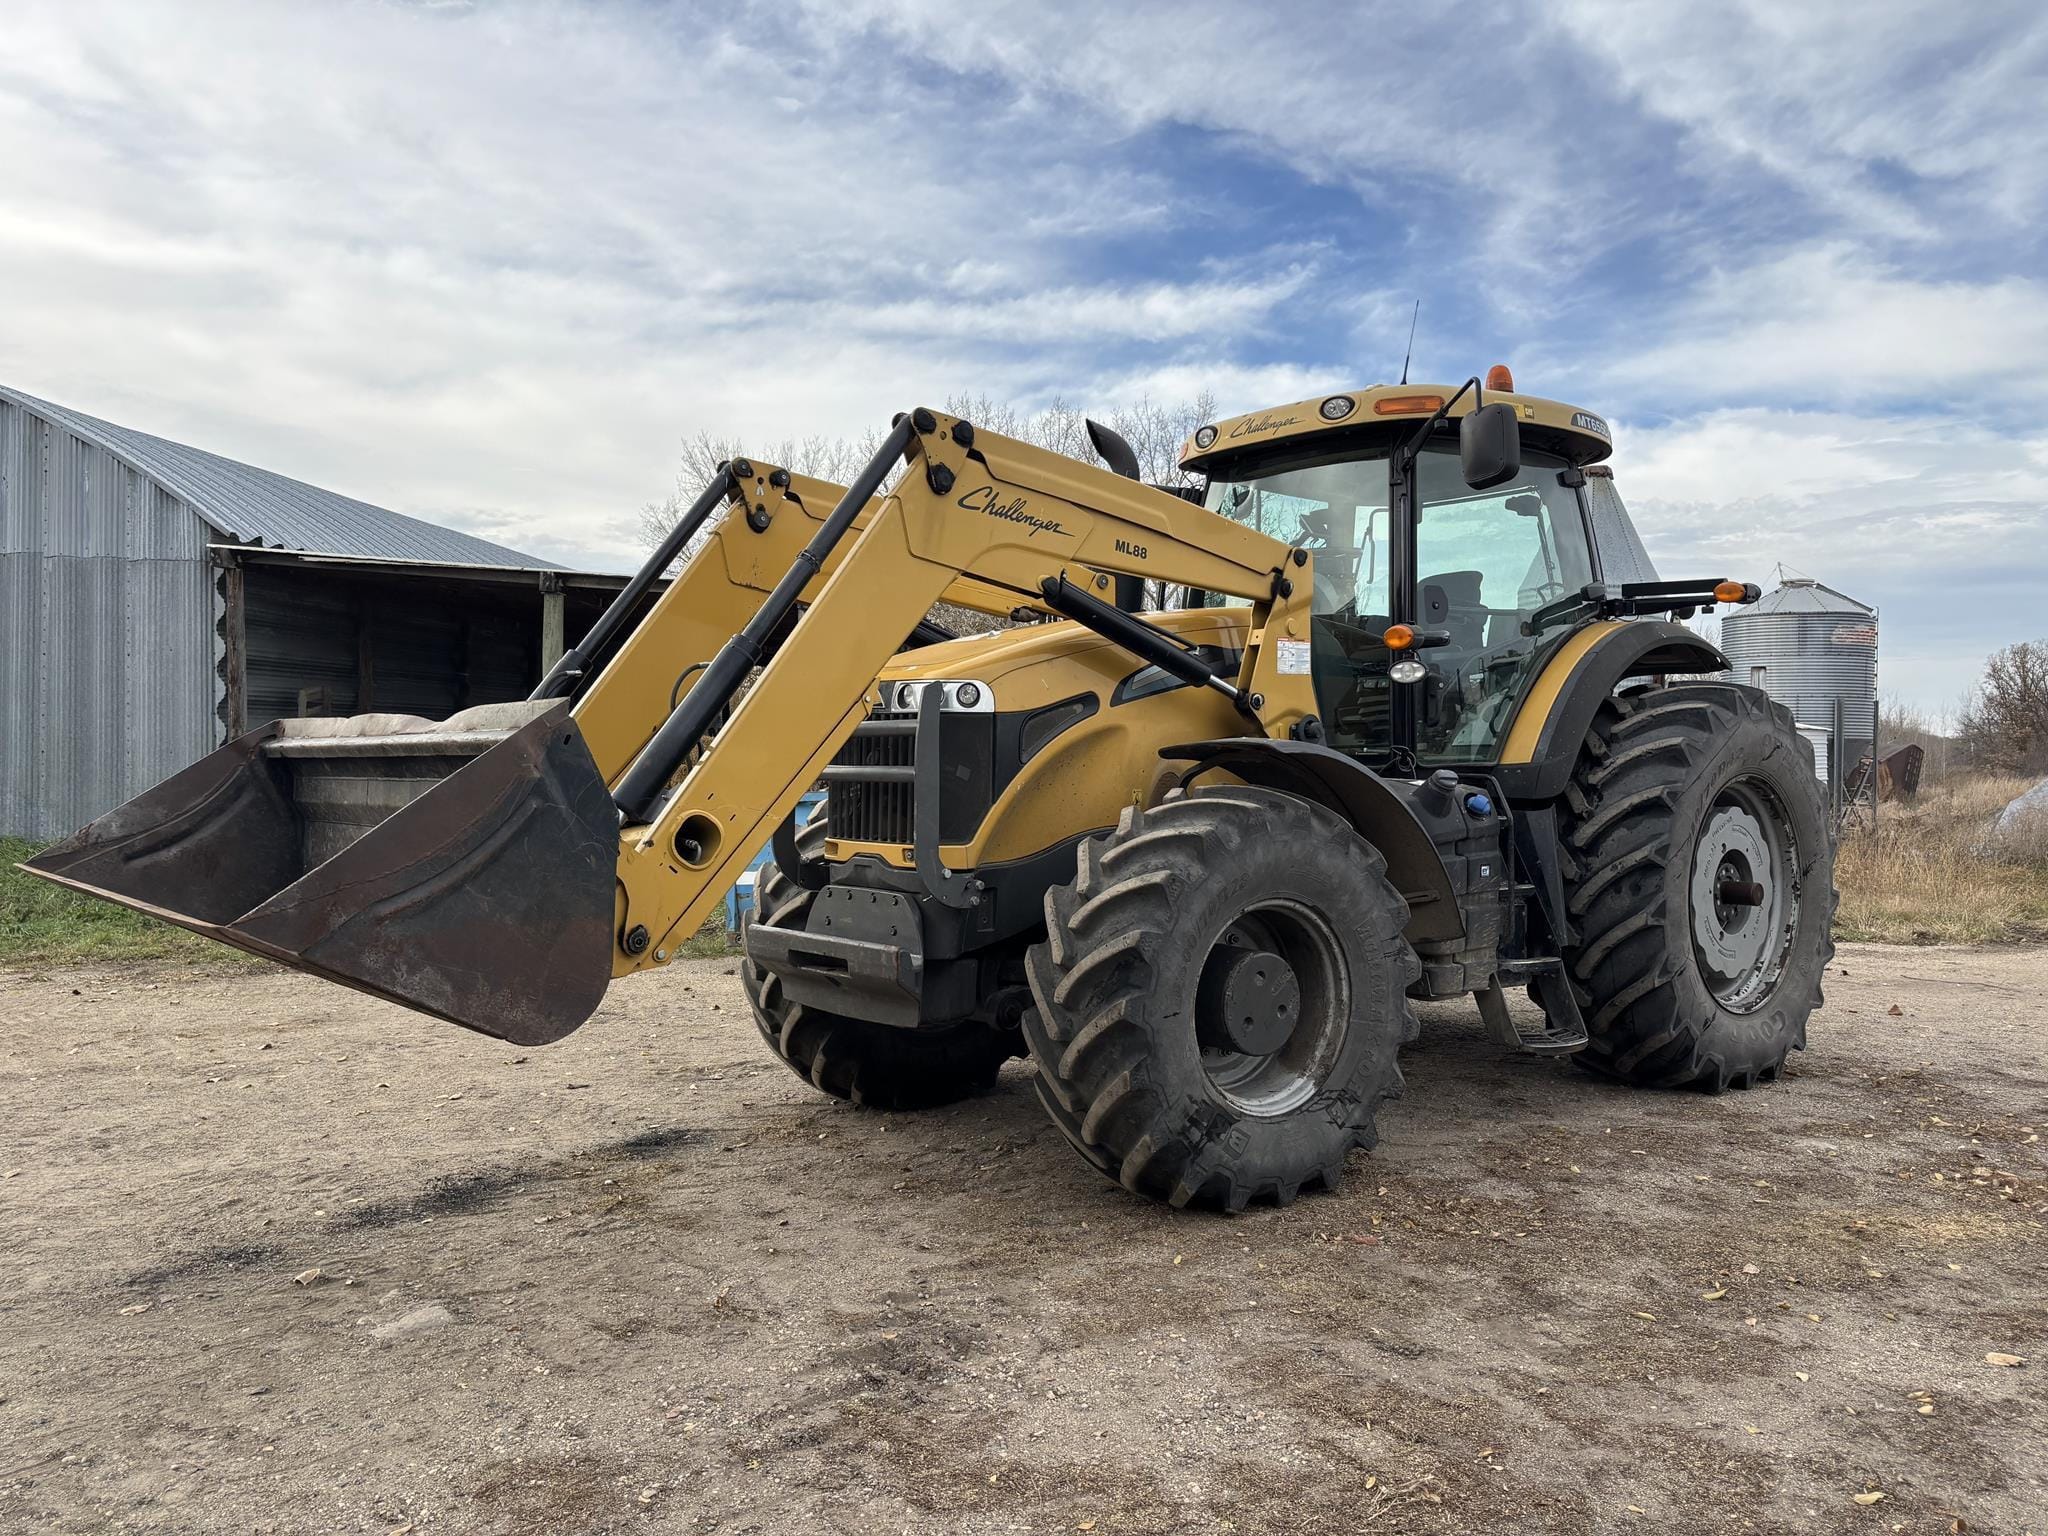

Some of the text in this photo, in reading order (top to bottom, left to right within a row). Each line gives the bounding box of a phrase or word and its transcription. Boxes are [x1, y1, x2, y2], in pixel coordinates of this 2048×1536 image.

[1230, 415, 1306, 438] Challenger
[958, 486, 1076, 537] Challenger
[1115, 539, 1147, 560] ML88
